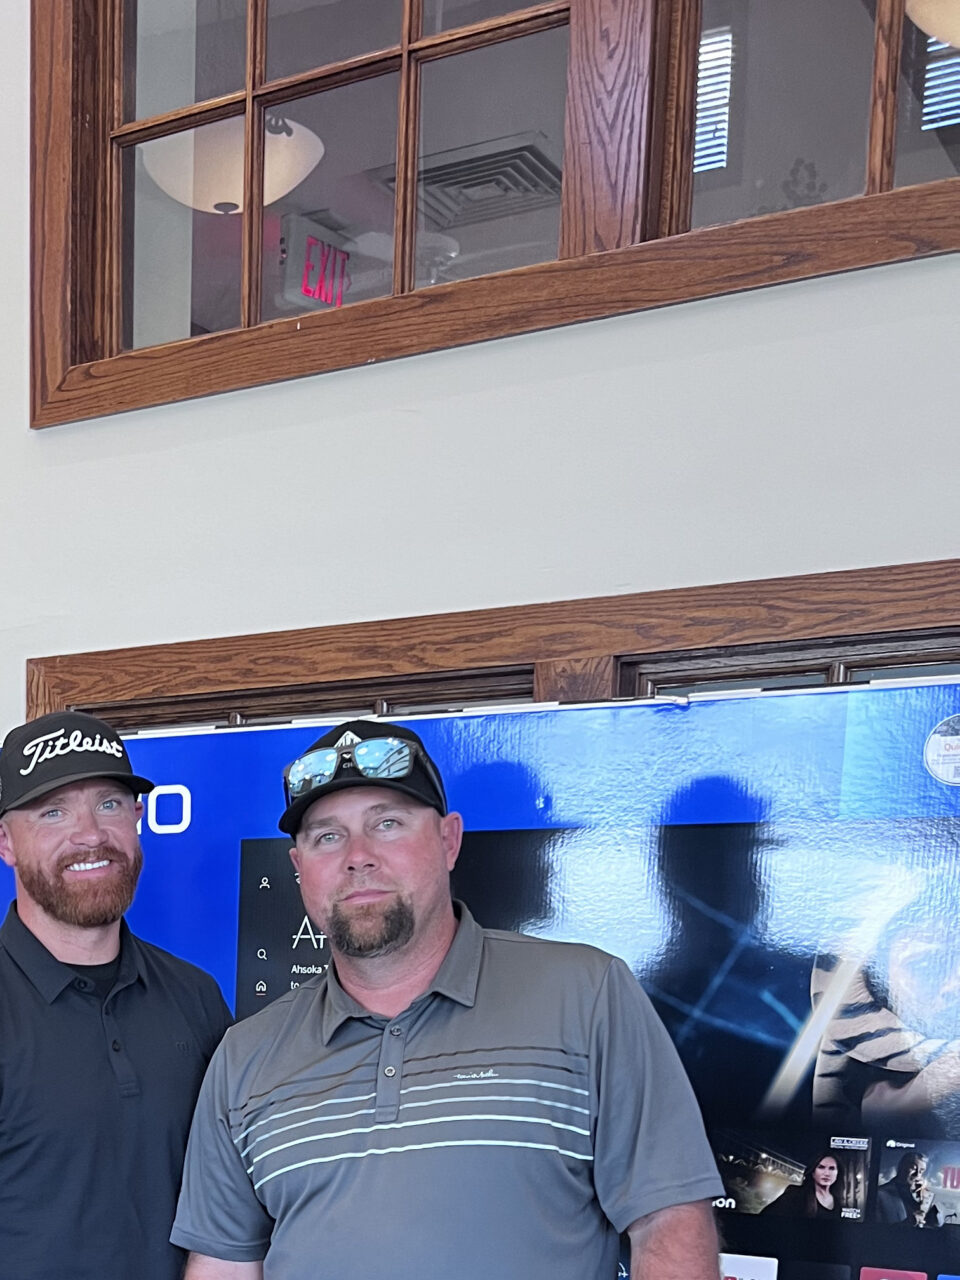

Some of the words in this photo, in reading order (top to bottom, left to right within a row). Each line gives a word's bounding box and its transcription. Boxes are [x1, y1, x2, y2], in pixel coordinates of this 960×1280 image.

[302, 235, 350, 308] EXIT
[19, 728, 123, 776] Titleist
[291, 964, 322, 974] Ahsoka
